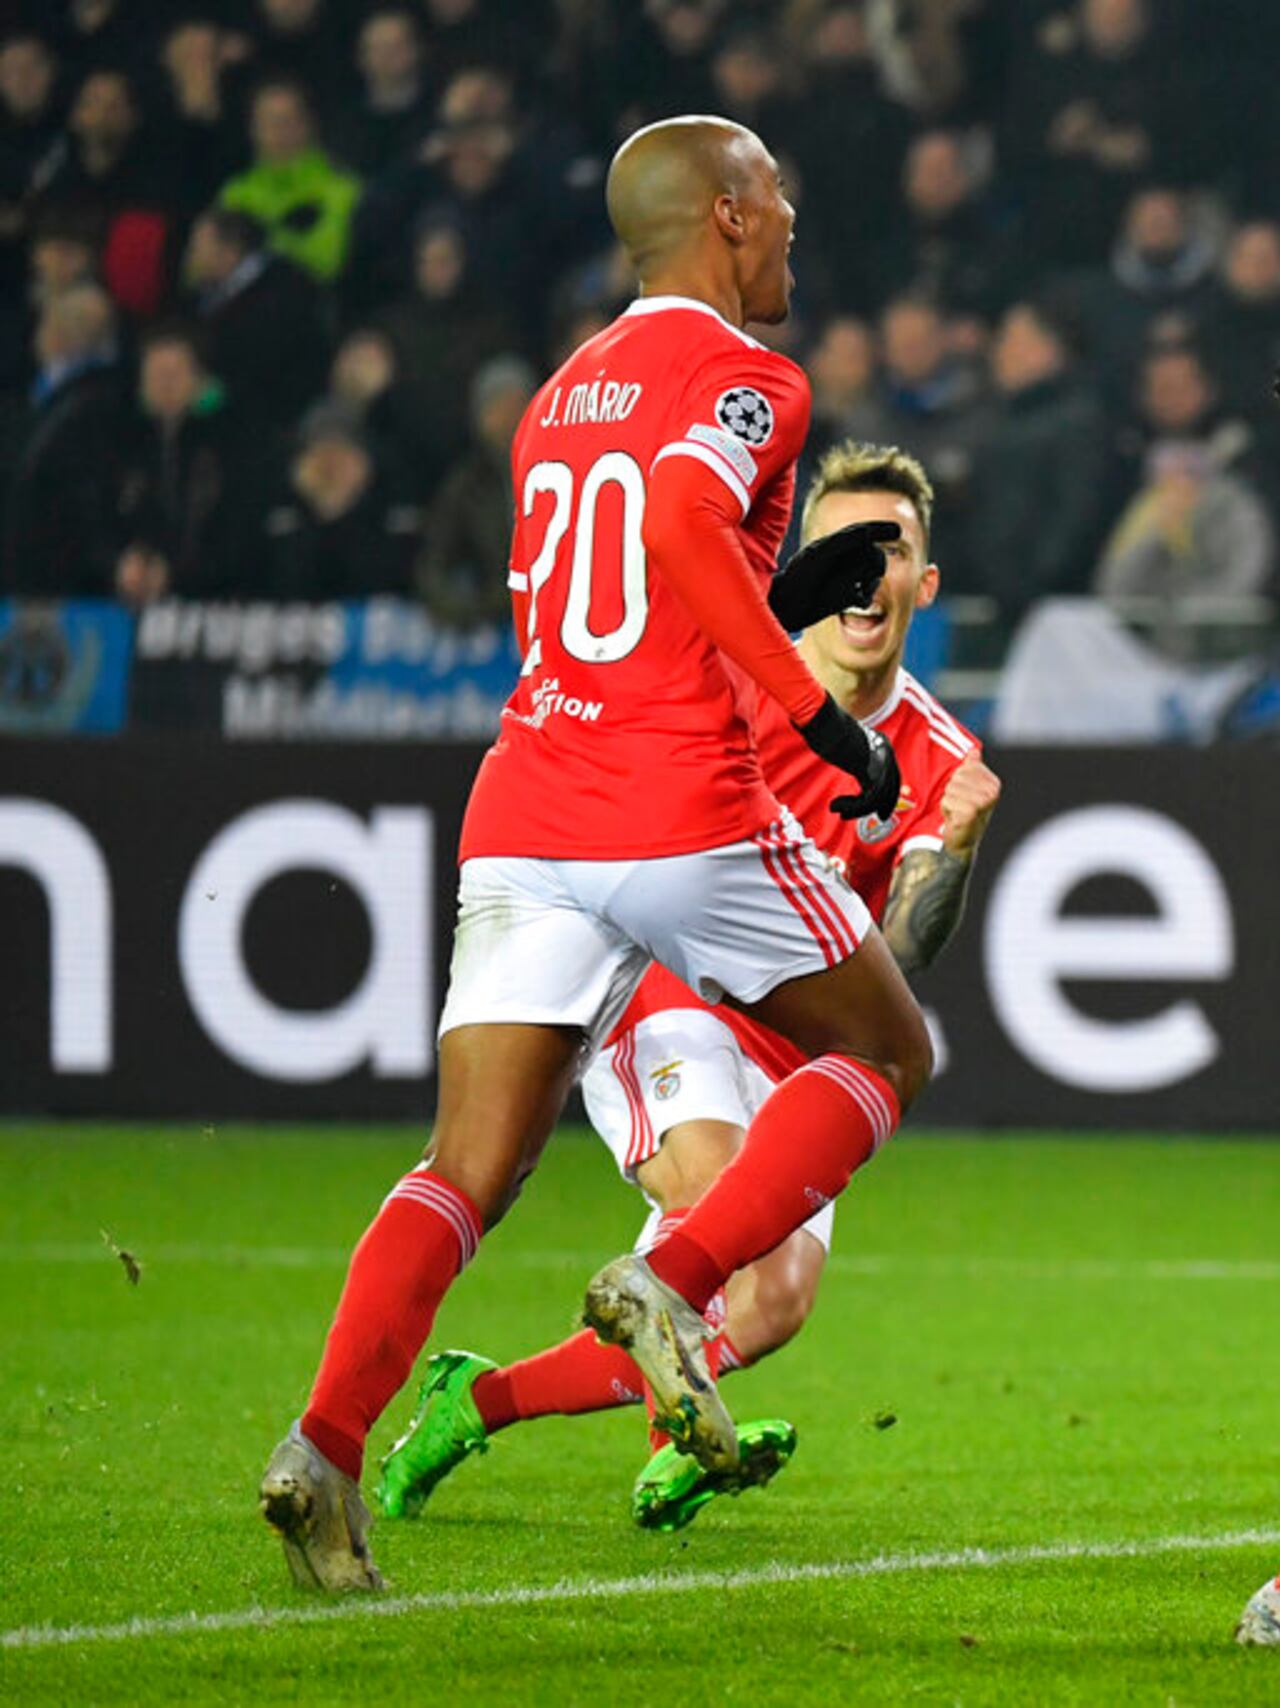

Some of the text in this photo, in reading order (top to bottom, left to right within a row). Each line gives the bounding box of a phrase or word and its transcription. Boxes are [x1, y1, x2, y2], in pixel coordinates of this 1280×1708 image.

[541, 370, 642, 427] J. MÁRIO
[522, 450, 648, 677] 20
